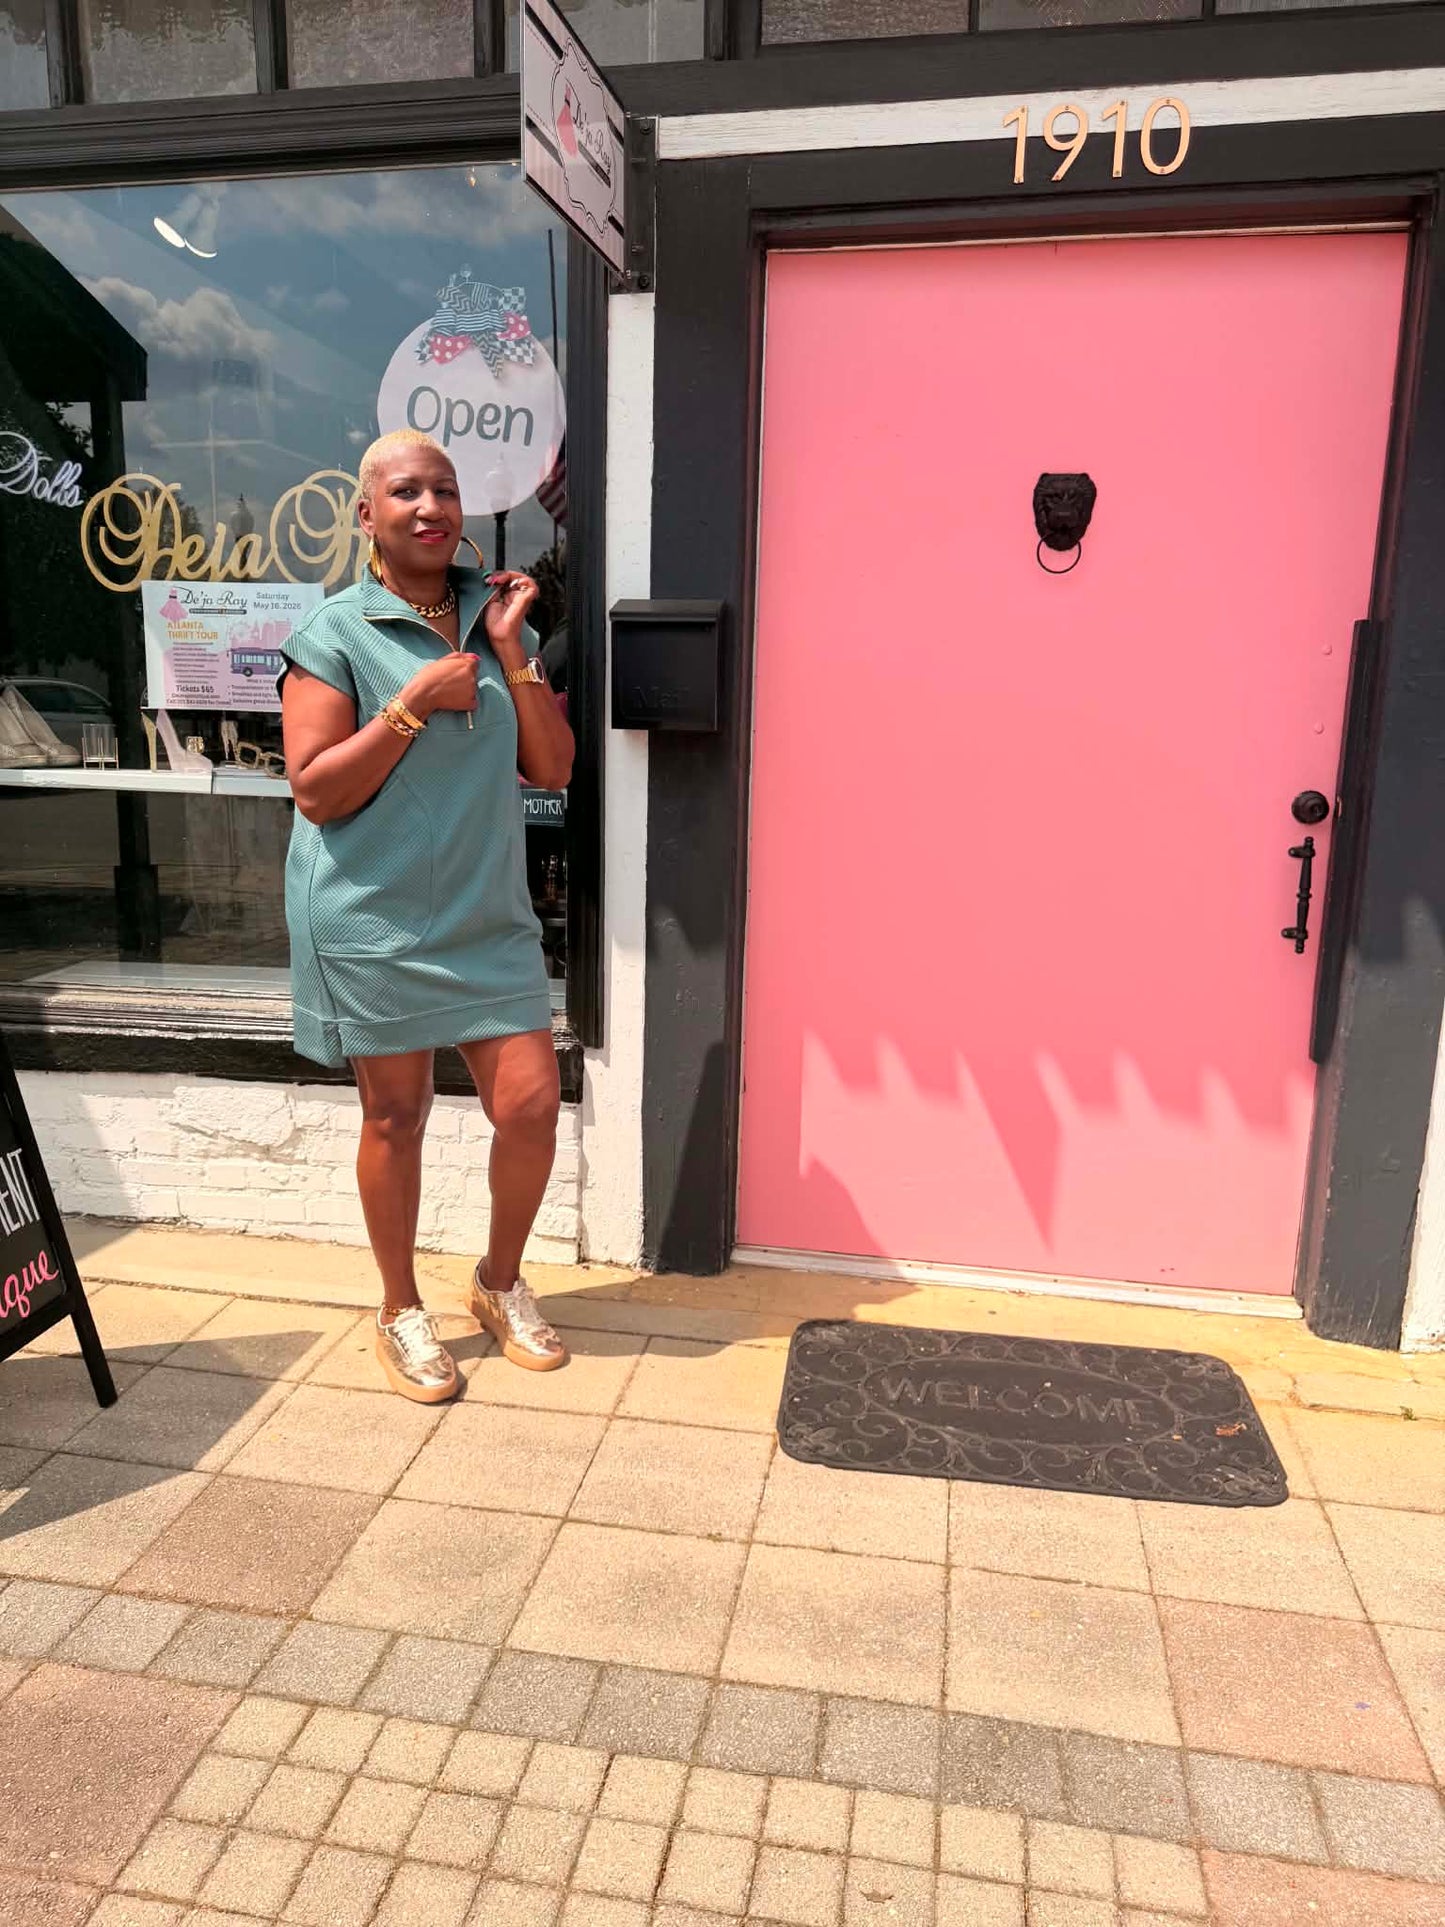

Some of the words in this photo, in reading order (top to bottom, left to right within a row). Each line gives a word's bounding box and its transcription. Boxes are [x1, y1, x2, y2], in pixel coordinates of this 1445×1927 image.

[1002, 97, 1190, 184] 1910
[406, 385, 534, 448] Open
[256, 592, 291, 601] Saturday
[253, 602, 270, 611] May
[167, 620, 205, 630] ATLANTA
[167, 630, 195, 640] THRIFT
[195, 631, 219, 640] TOUR
[175, 684, 200, 693] Tickets
[523, 798, 563, 816] MOTHER
[0, 1148, 40, 1237] ENT
[880, 1375, 1157, 1427] WELCOME
